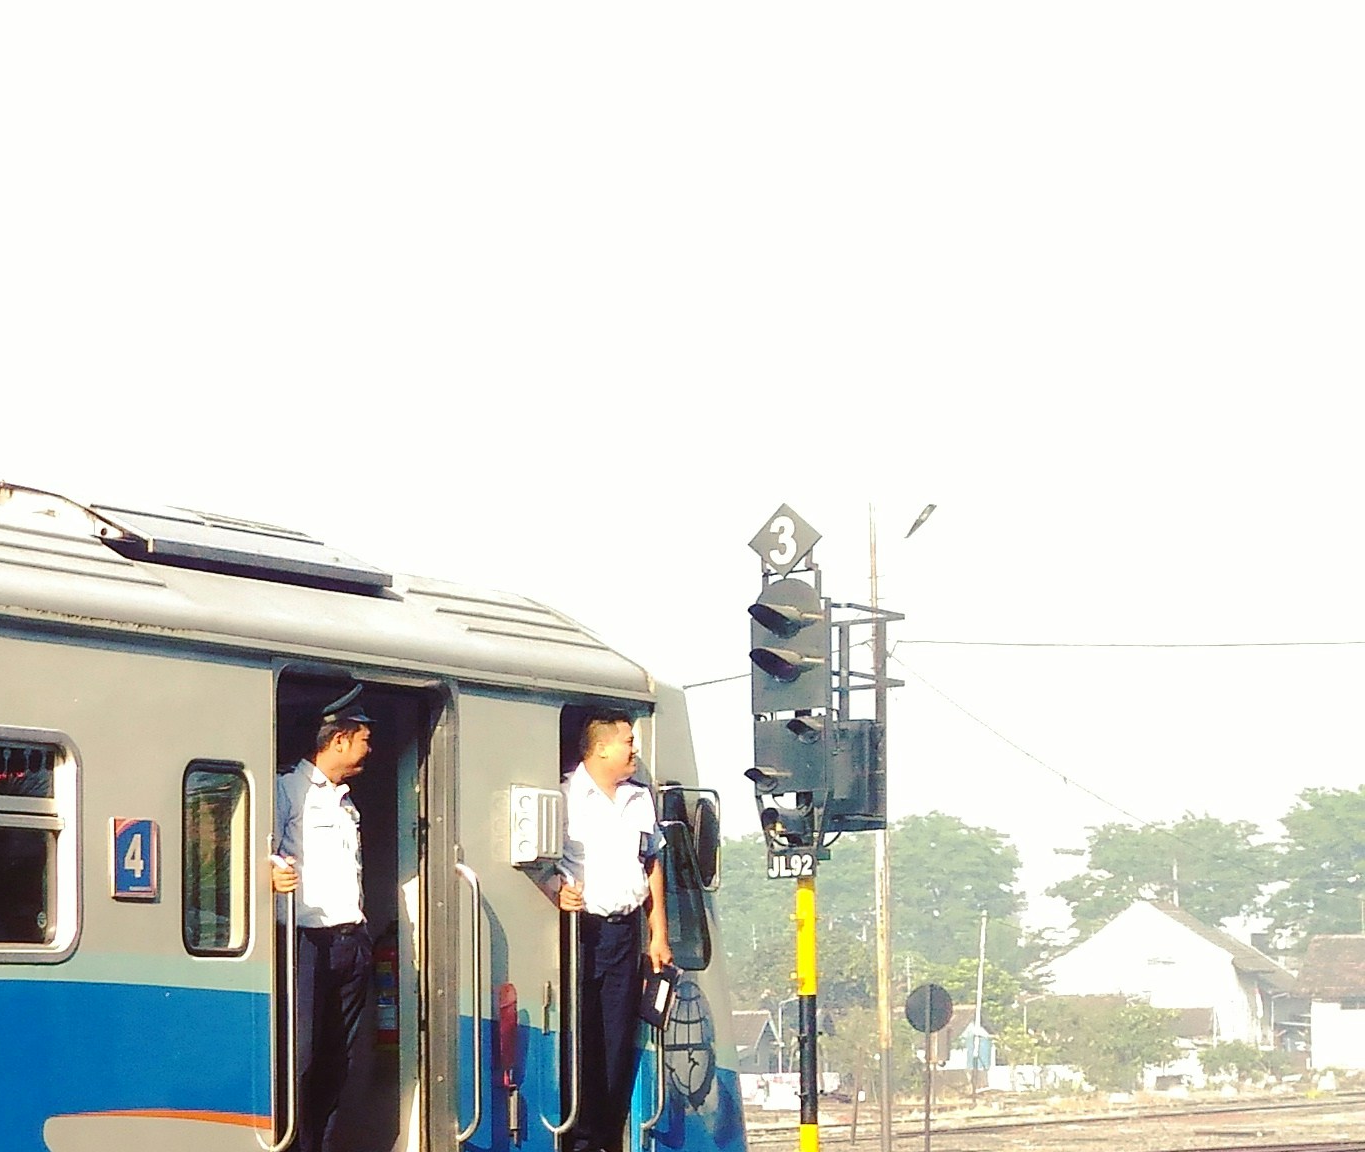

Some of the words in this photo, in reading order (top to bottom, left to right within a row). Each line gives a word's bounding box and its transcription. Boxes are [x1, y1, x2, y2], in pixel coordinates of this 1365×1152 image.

[770, 516, 798, 565] 3
[124, 833, 144, 878] 4
[768, 854, 813, 878] JL92
